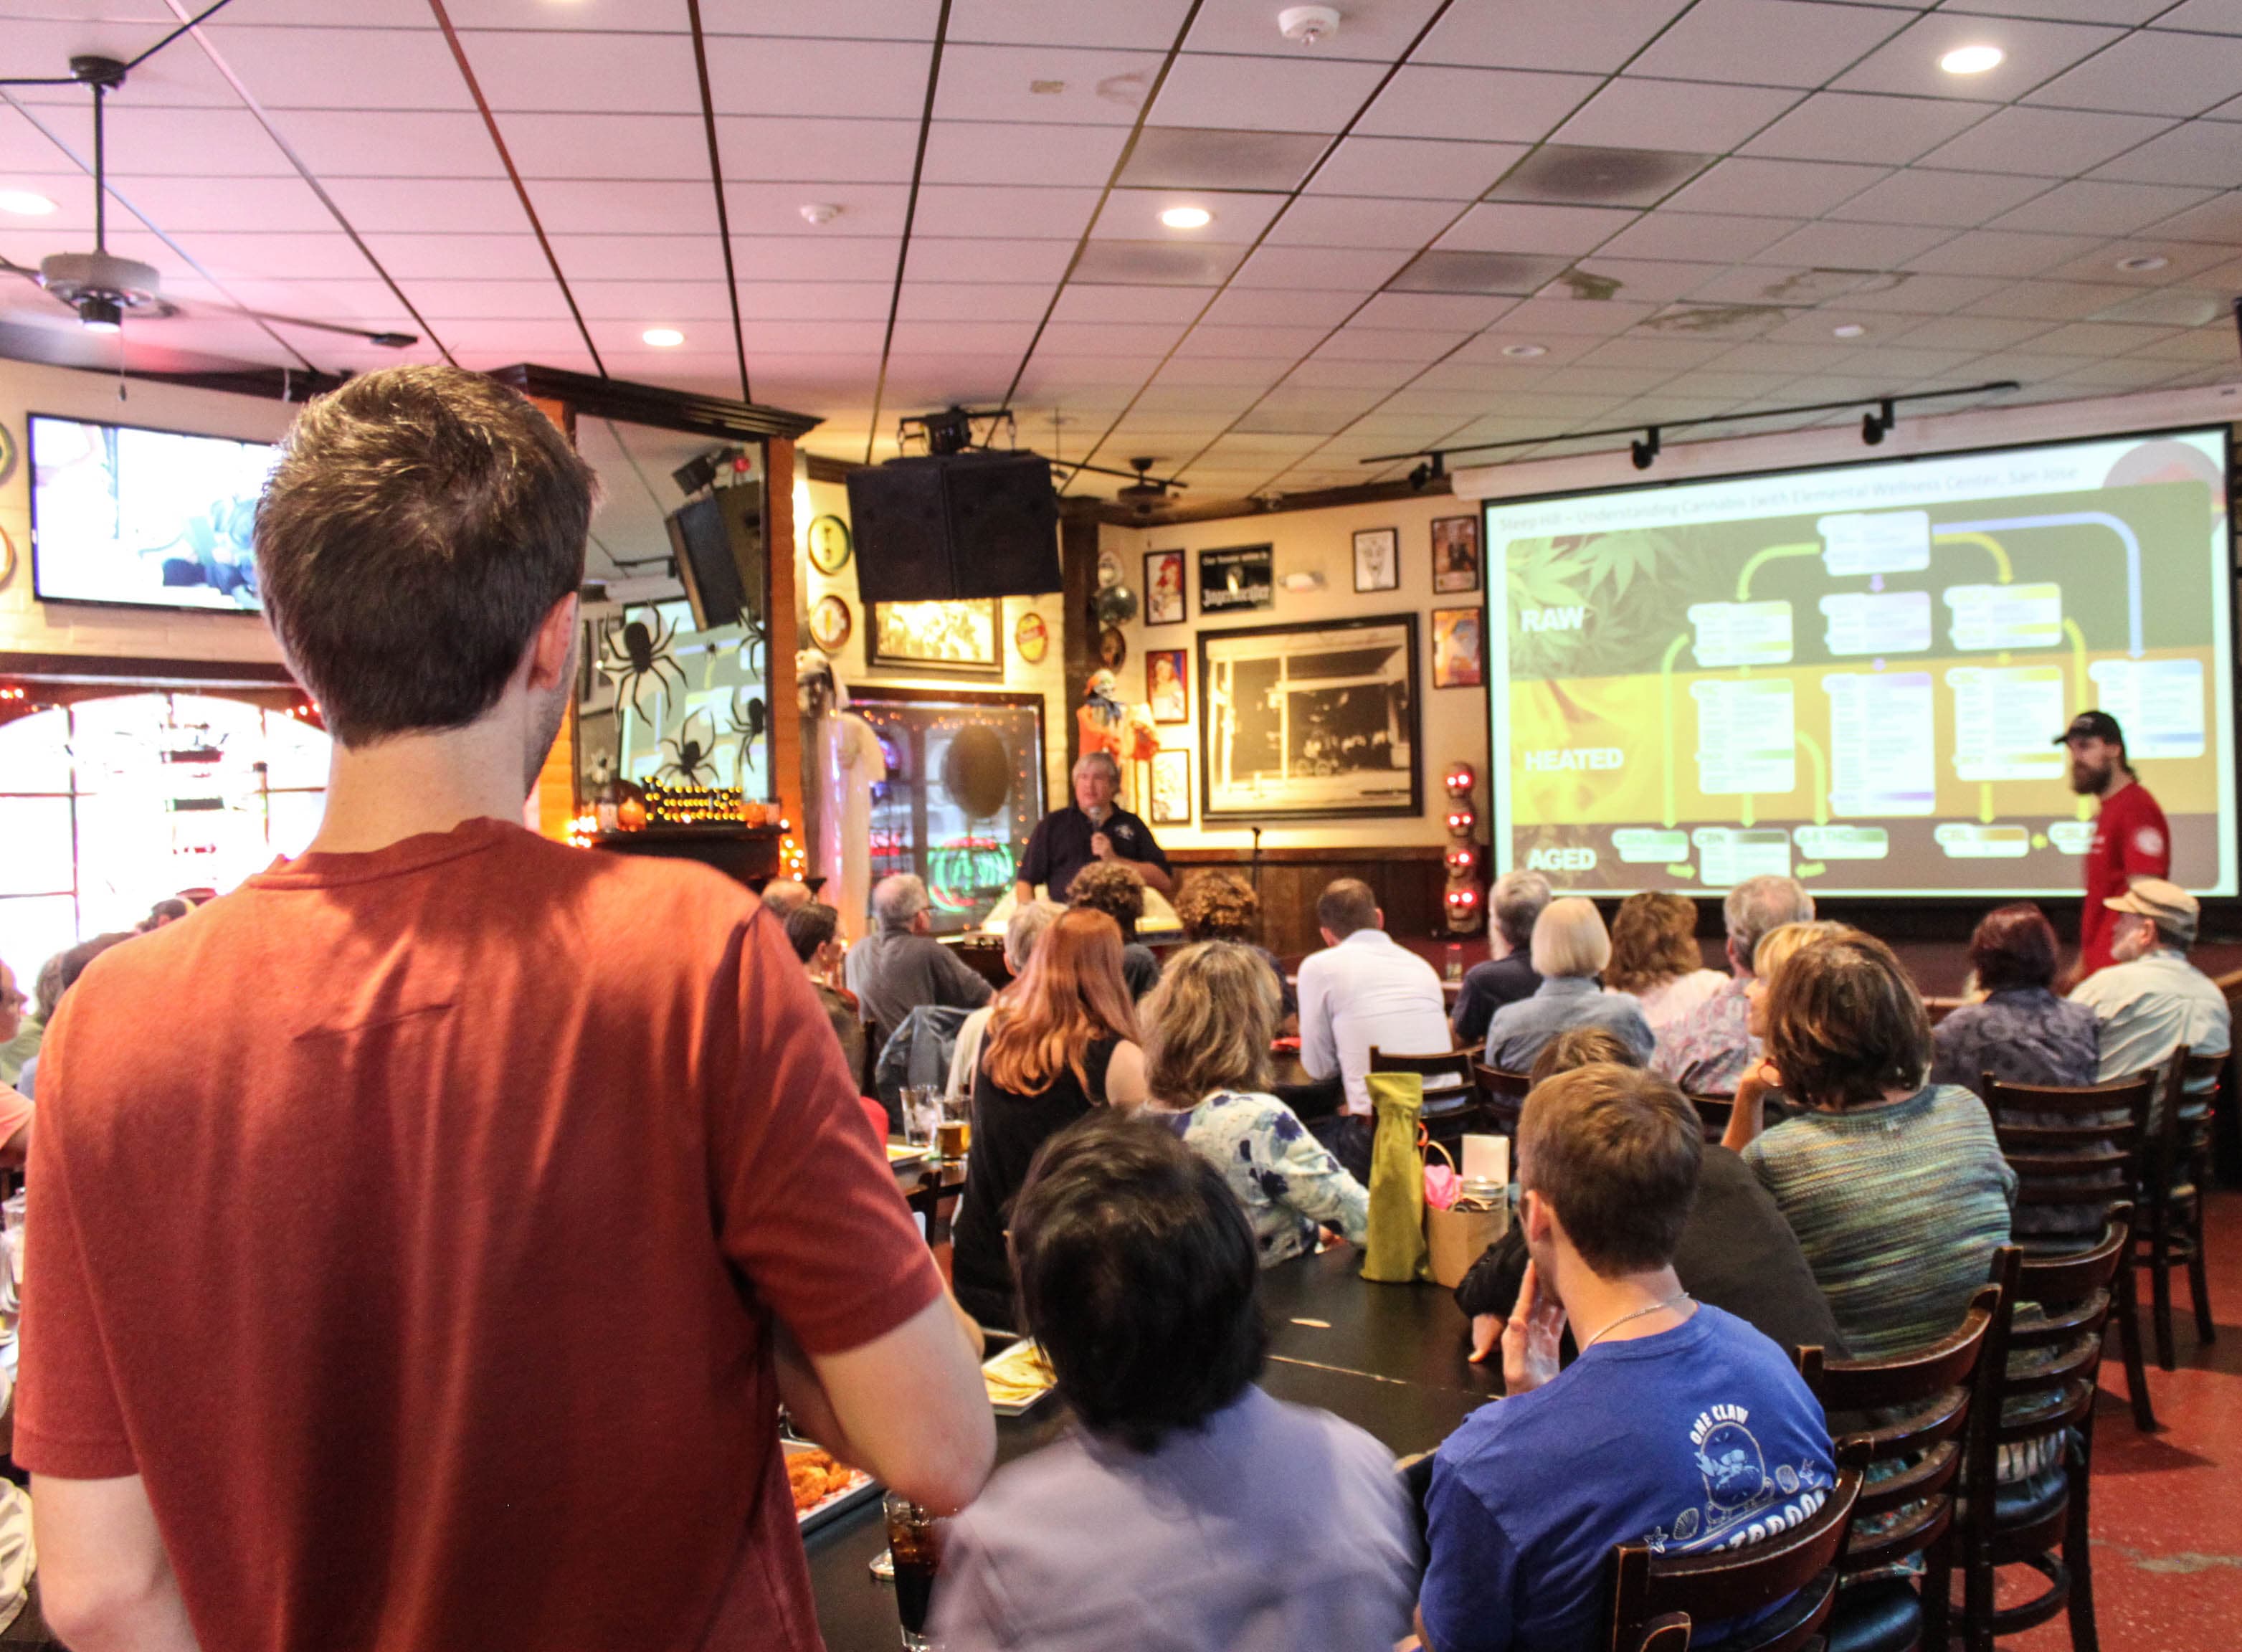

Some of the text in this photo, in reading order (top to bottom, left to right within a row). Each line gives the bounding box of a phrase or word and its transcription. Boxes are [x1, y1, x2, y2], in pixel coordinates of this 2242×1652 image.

[1577, 503, 1678, 523] Understanding
[1679, 496, 1747, 512] Cannabis
[1793, 485, 1870, 505] Elemental
[1873, 480, 1942, 498] Wellness
[2008, 470, 2038, 485] San
[1521, 606, 1584, 632] RAW
[1524, 747, 1625, 772] HEATED
[1526, 848, 1597, 871] AGED
[1689, 1404, 1749, 1446] ONE CLAW
